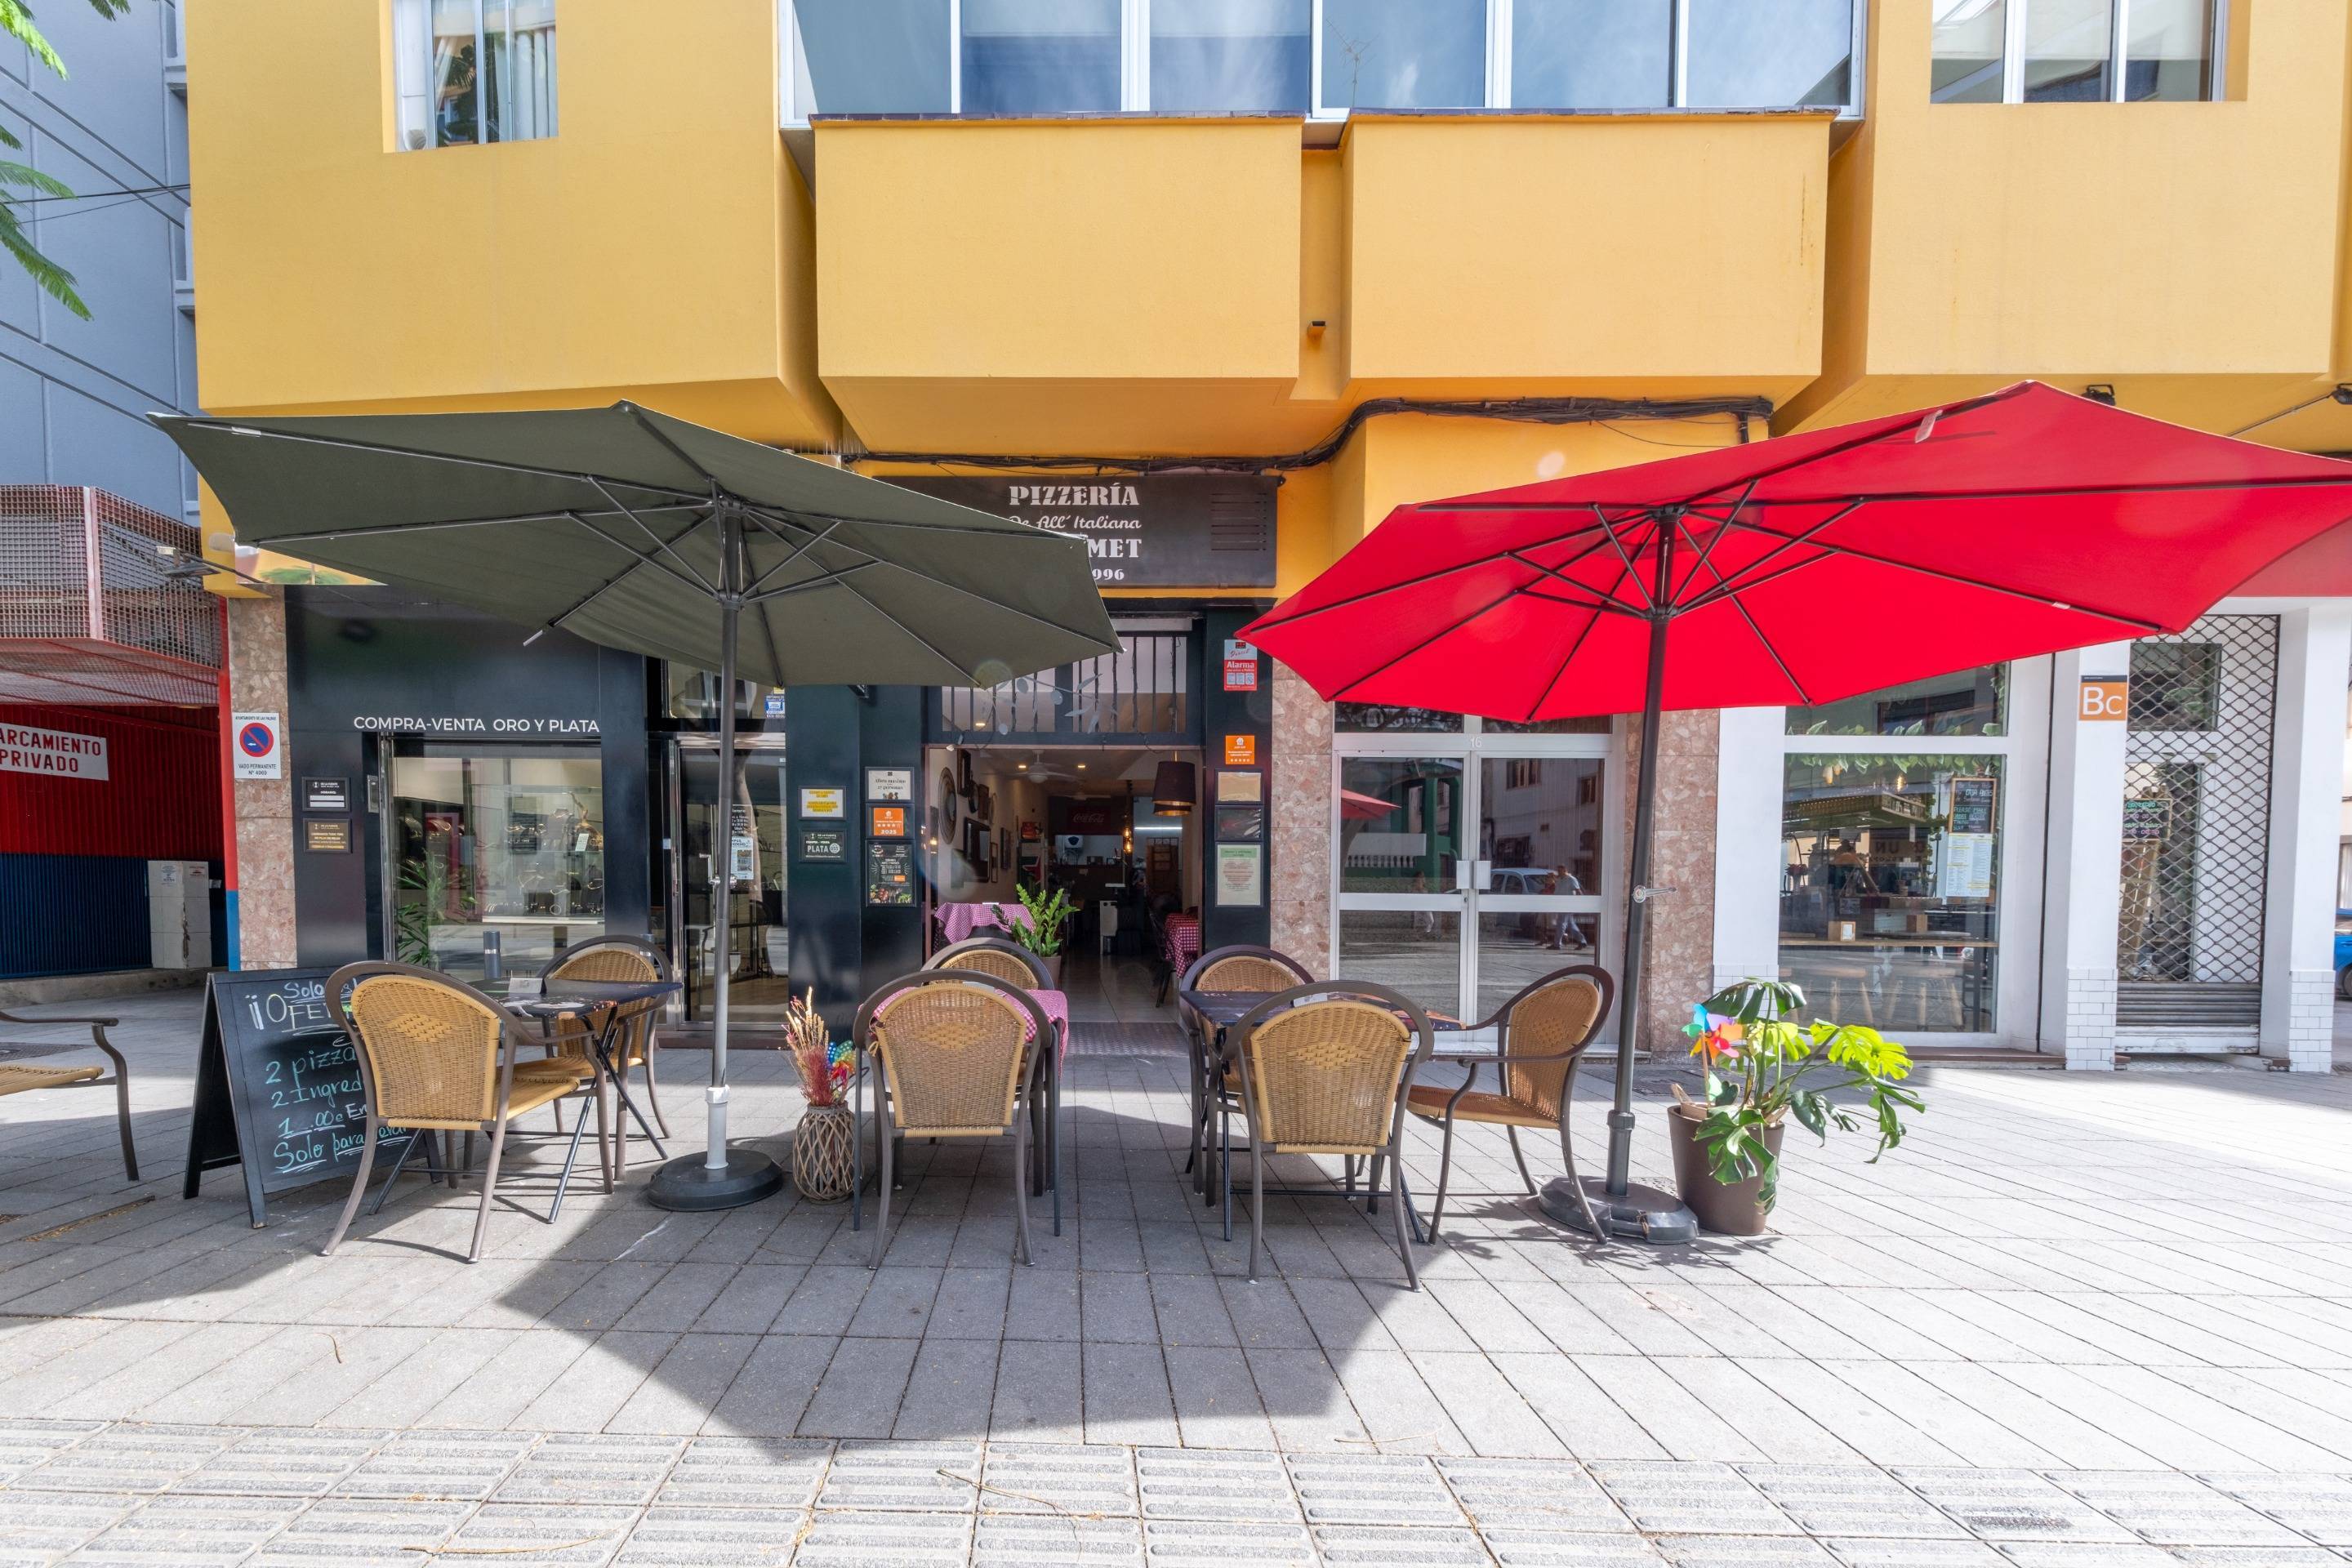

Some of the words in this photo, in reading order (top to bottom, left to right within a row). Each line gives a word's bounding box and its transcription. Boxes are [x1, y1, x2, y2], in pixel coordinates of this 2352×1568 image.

[1009, 482, 1140, 506] PIZZERÍA
[1074, 515, 1142, 529] Italiana
[1088, 538, 1143, 558] MET
[1092, 568, 1125, 581] 996
[1227, 661, 1255, 669] Alarma
[2083, 686, 2123, 716] Bc
[354, 716, 486, 731] COMPRA-VENTA
[493, 719, 530, 732] ORO
[534, 719, 545, 732] Y
[549, 719, 600, 733] PLATA
[1470, 737, 1482, 747] 16
[0, 749, 78, 773] PRIVADO
[283, 981, 325, 999] Solo
[265, 1061, 281, 1085] 2
[292, 1047, 356, 1089] pizza
[271, 1091, 289, 1109] 2
[274, 1134, 324, 1169] Solo
[332, 1133, 364, 1162] para
